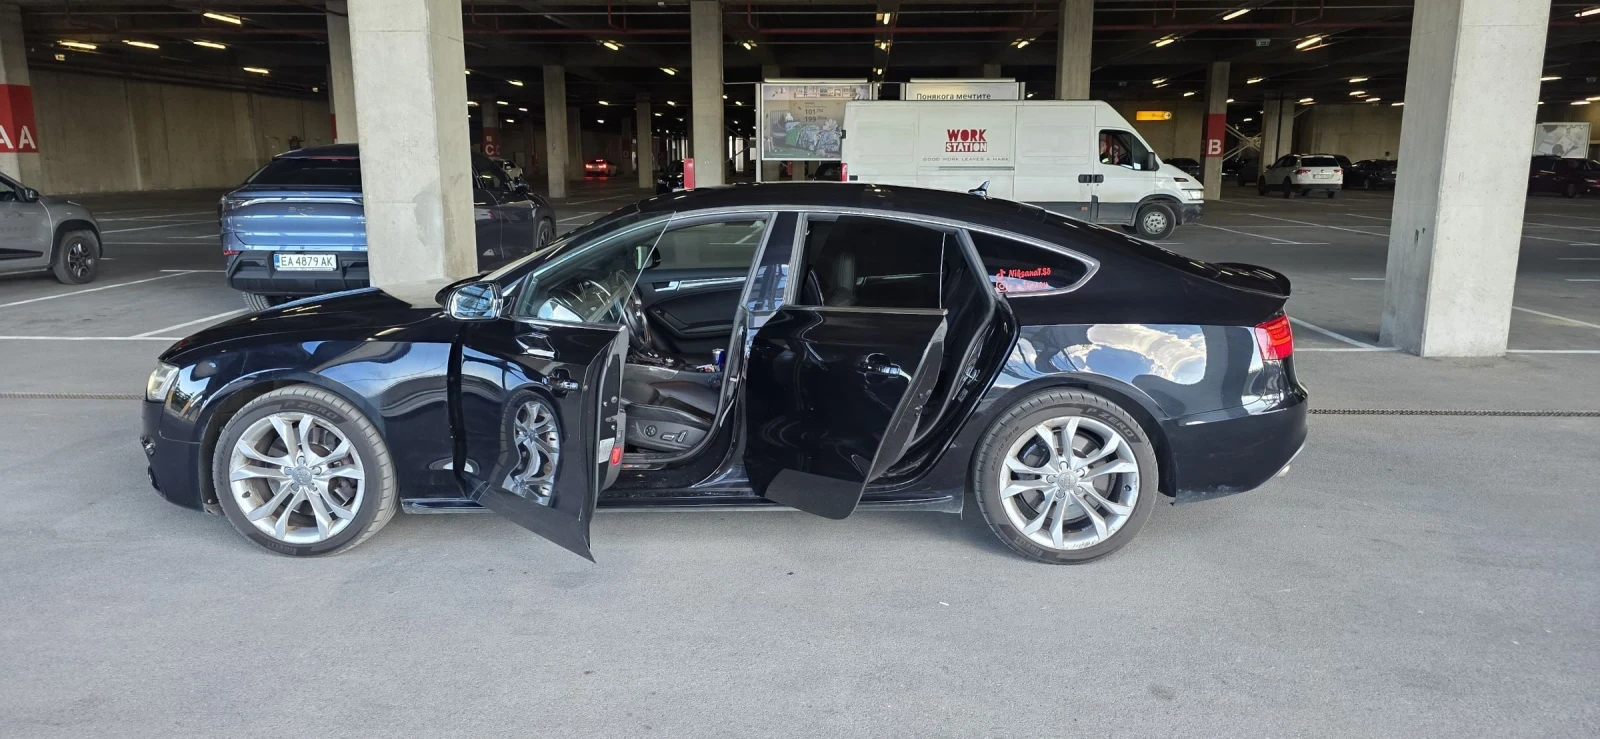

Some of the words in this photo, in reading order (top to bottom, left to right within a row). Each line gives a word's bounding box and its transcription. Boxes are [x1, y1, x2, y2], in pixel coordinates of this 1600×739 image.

[19, 125, 36, 149] A
[946, 129, 987, 142] WORK
[485, 144, 494, 155] C
[946, 142, 987, 152] STATION
[1208, 139, 1222, 155] B
[281, 257, 294, 266] EA
[295, 257, 319, 266] 4879
[321, 257, 333, 266] AK
[1099, 411, 1135, 438] ZERO
